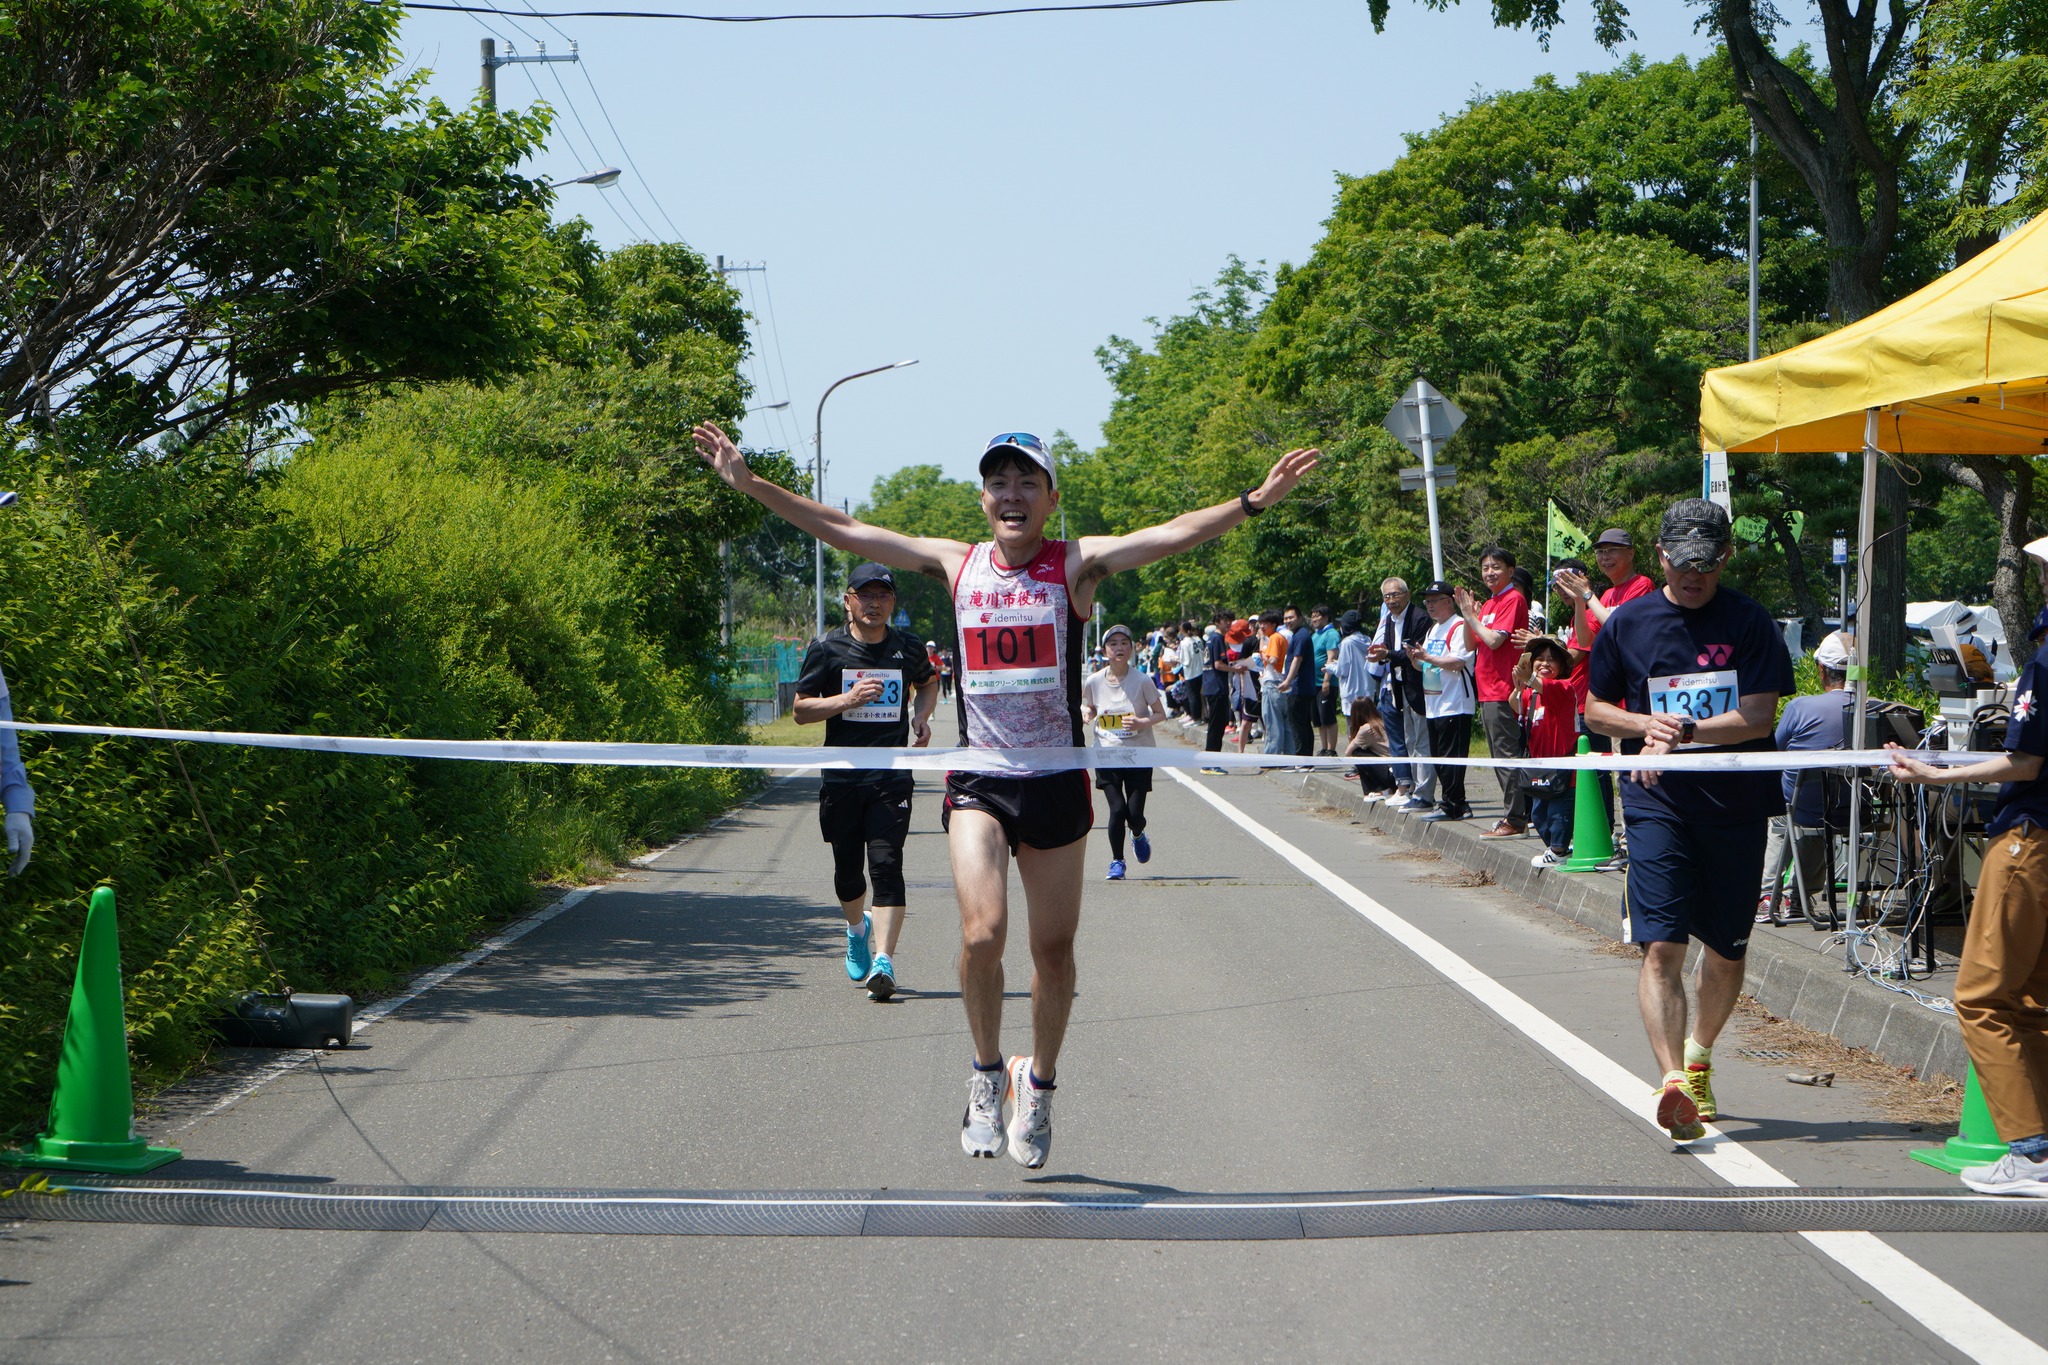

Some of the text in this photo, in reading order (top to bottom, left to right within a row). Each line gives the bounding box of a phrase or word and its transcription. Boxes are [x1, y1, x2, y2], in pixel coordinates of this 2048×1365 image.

[969, 588, 1049, 608] 滝川市役所
[994, 612, 1033, 623] idemitsu
[976, 627, 1037, 665] 101
[978, 677, 1056, 688] 北海道グリーン開発 株式会社
[1682, 676, 1718, 687] idemitsu
[1657, 687, 1732, 721] 1337
[1531, 778, 1551, 786] FILA
